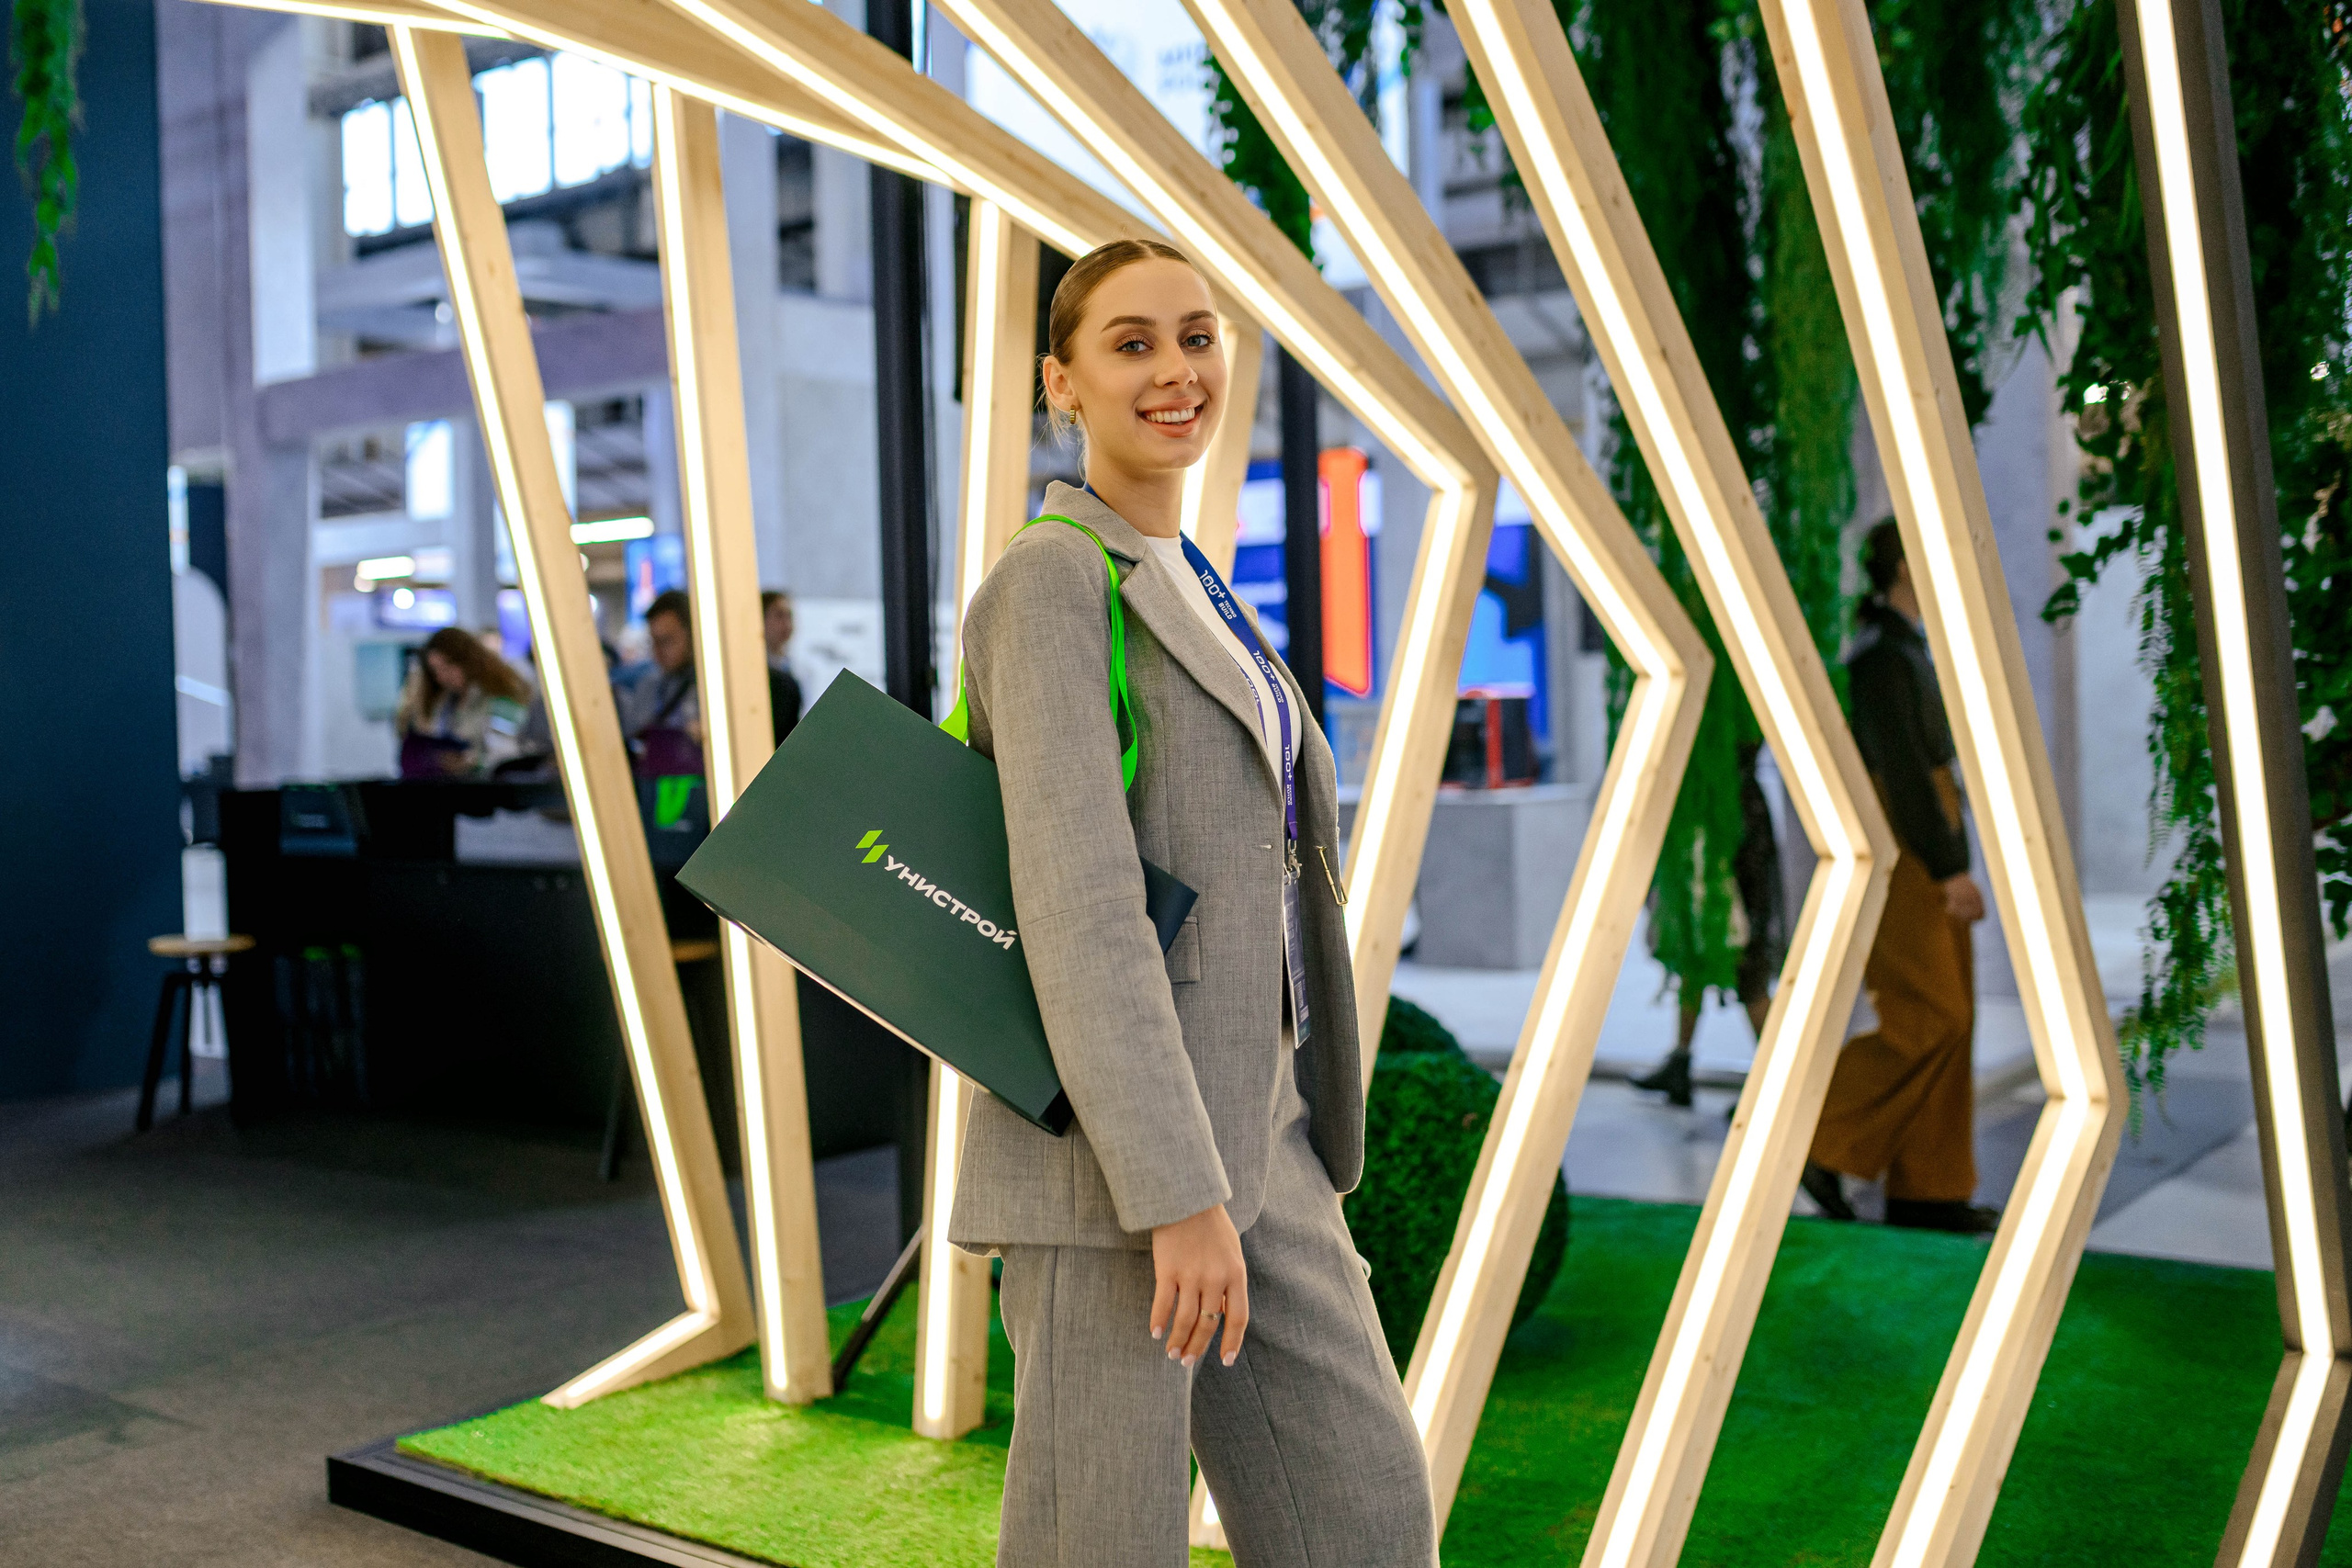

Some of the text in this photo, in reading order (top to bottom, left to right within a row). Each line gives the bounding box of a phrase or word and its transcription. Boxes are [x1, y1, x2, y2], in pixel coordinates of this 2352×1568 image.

[1199, 570, 1226, 599] 100+
[1218, 602, 1233, 620] BUILD
[1224, 600, 1237, 618] TECHNO
[1253, 650, 1275, 681] 100+
[1284, 744, 1293, 781] 100+
[884, 854, 1018, 951] УНИСТРОЙ
